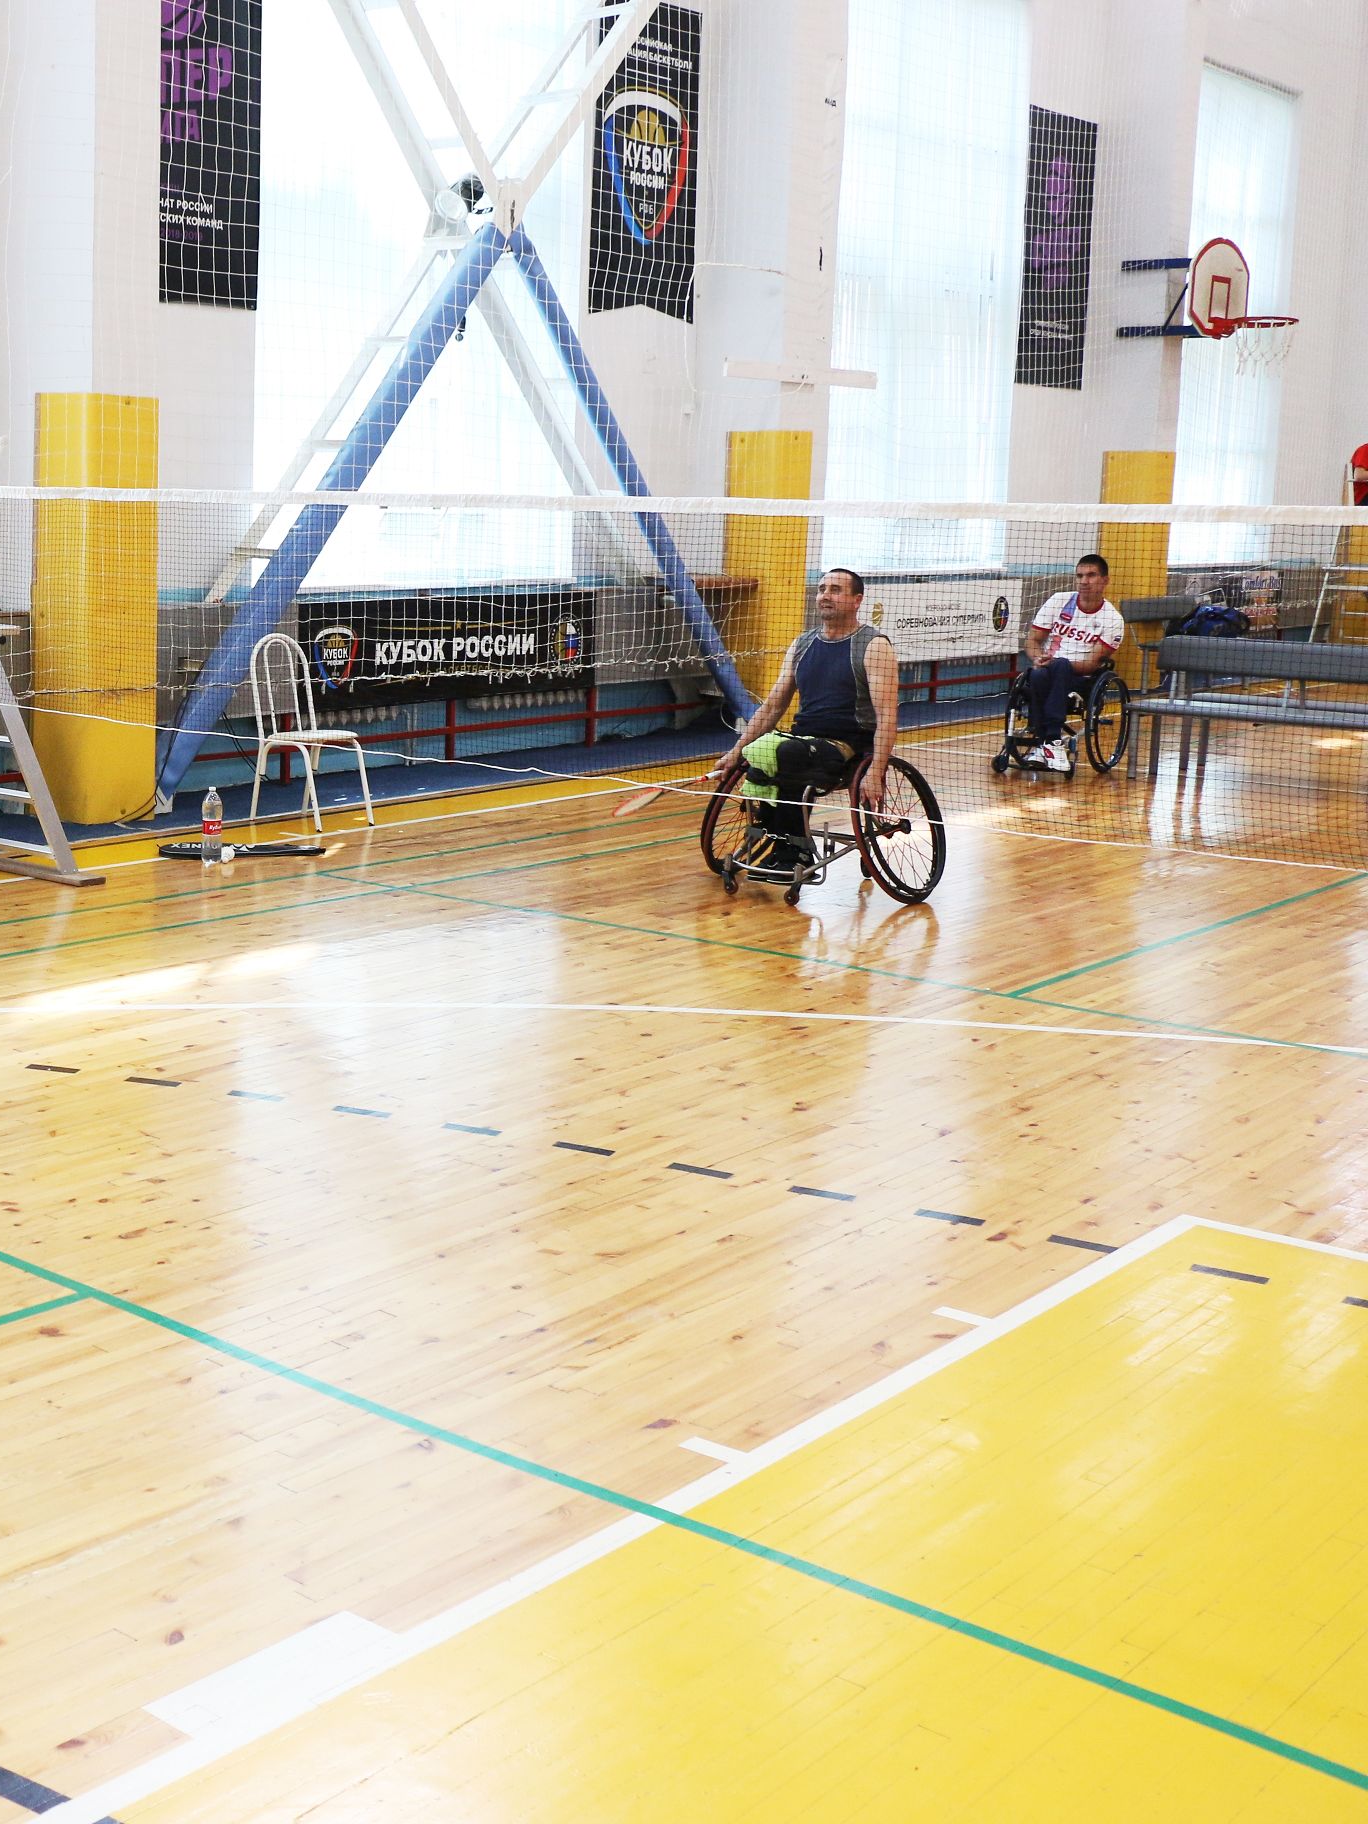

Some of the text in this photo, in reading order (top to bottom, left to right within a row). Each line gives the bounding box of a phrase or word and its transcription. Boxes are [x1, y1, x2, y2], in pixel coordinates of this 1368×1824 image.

[623, 138, 673, 174] КУБОК
[629, 171, 665, 189] РОССИИ
[176, 200, 213, 214] РОССИИ
[186, 216, 224, 230] КОМАНД
[896, 615, 951, 629] СОРЕВНОВАНИЯ
[323, 647, 349, 660] КУБОК
[375, 633, 535, 666] КУБОК РОССИИ
